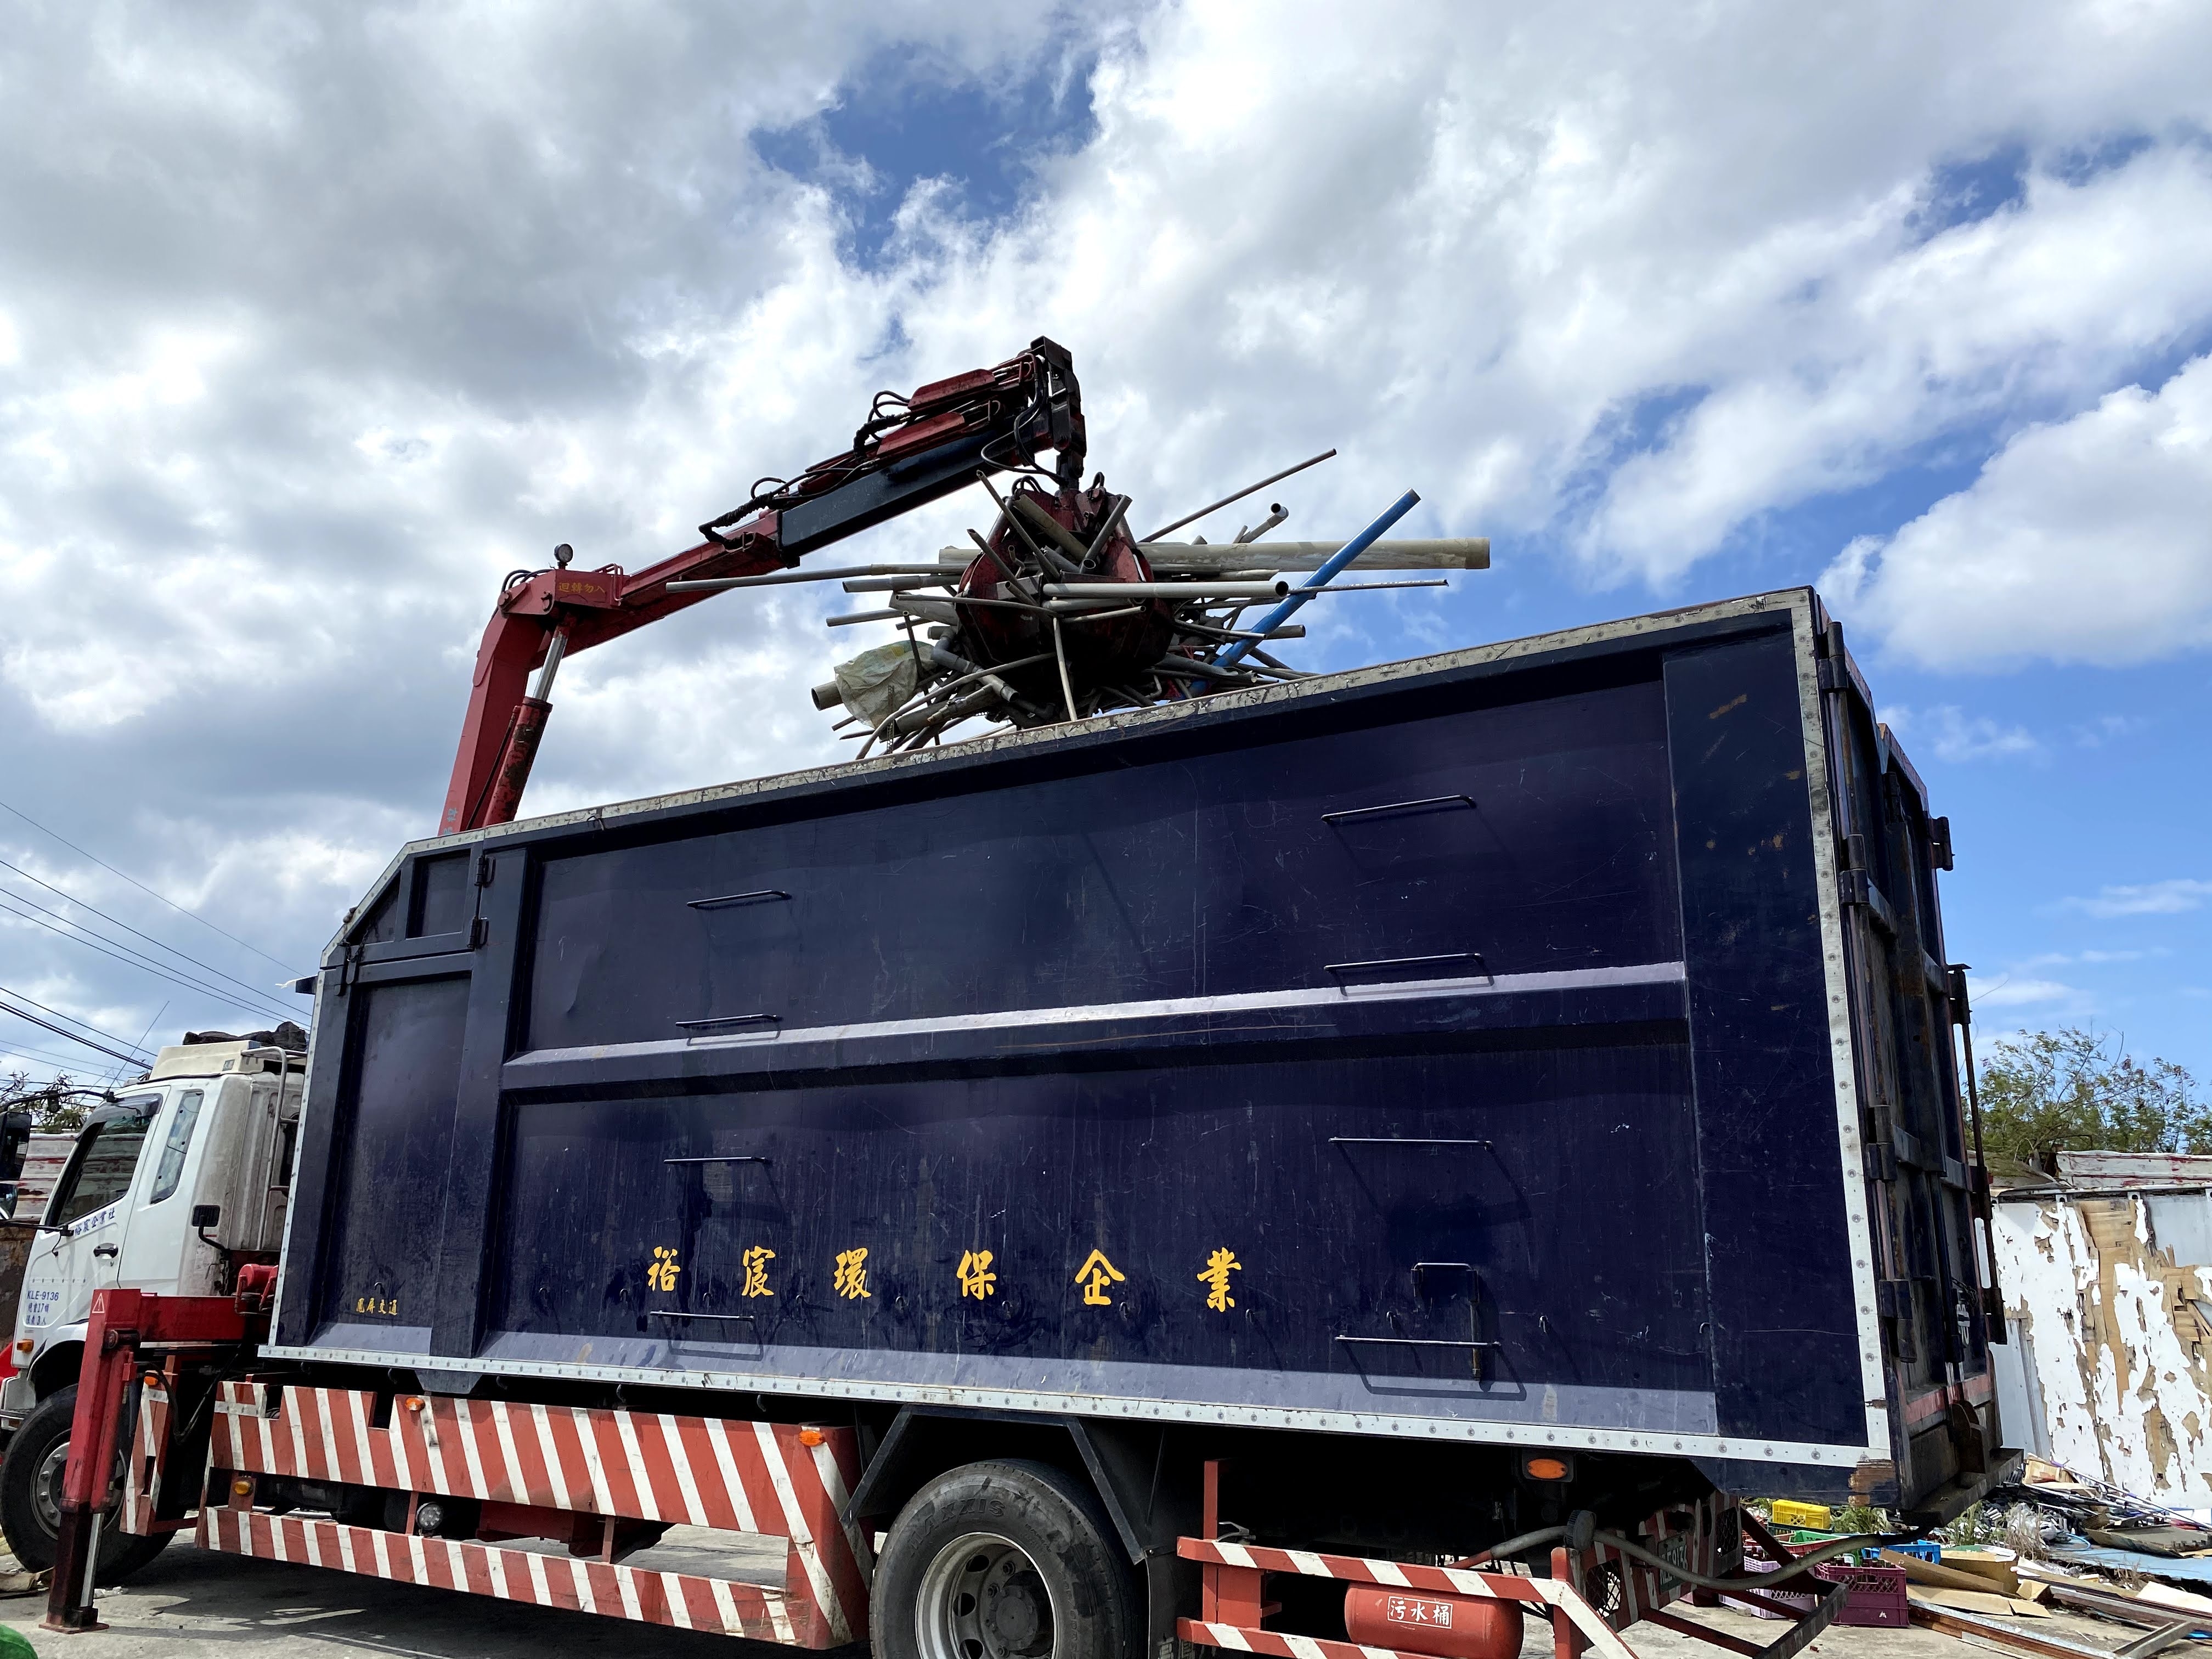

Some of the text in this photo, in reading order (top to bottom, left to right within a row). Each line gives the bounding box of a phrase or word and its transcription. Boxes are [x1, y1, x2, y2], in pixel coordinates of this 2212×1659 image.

[647, 1245, 1242, 1312] 裕宸環保企業
[26, 1290, 59, 1301] KLE-9136
[1390, 1600, 1449, 1626] 污水桶
